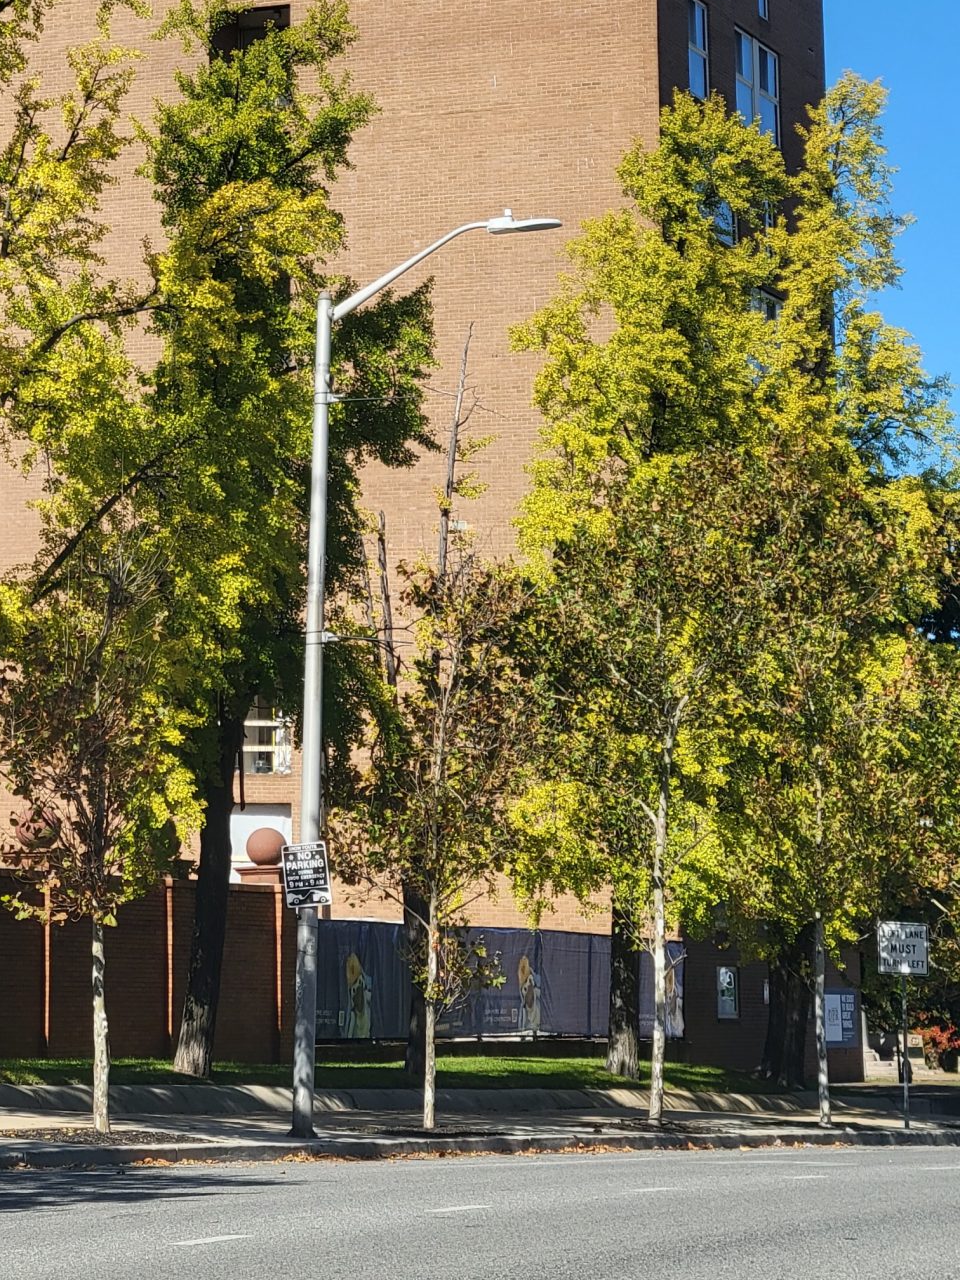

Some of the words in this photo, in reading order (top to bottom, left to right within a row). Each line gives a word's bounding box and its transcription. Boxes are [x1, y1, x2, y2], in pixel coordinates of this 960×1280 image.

[297, 851, 312, 860] NO
[286, 859, 324, 870] PARKING
[905, 930, 924, 939] LANE
[890, 943, 917, 954] MUST
[907, 960, 925, 969] LEFT
